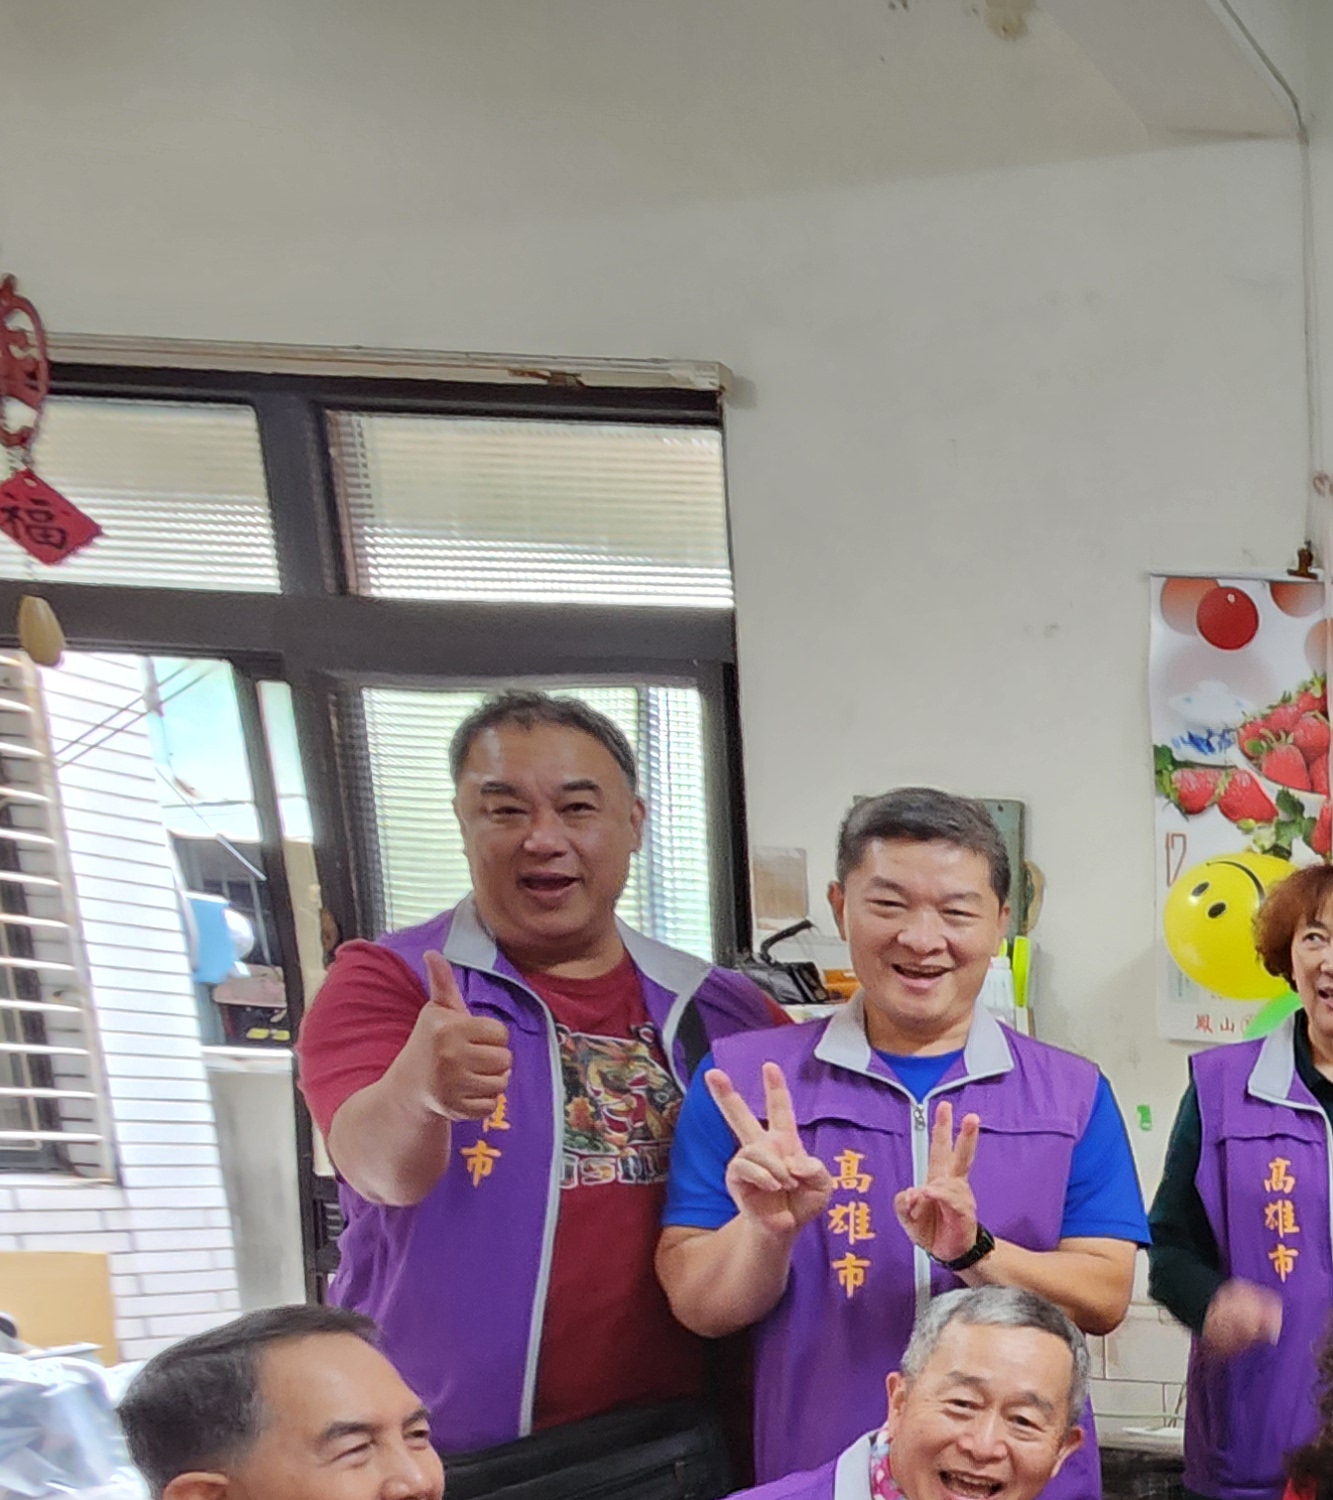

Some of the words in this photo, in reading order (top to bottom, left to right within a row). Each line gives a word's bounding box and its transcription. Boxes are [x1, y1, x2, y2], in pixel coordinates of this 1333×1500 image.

[0, 491, 67, 551] 福
[828, 1148, 877, 1300] 高雄市
[1263, 1156, 1302, 1283] 高雄市
